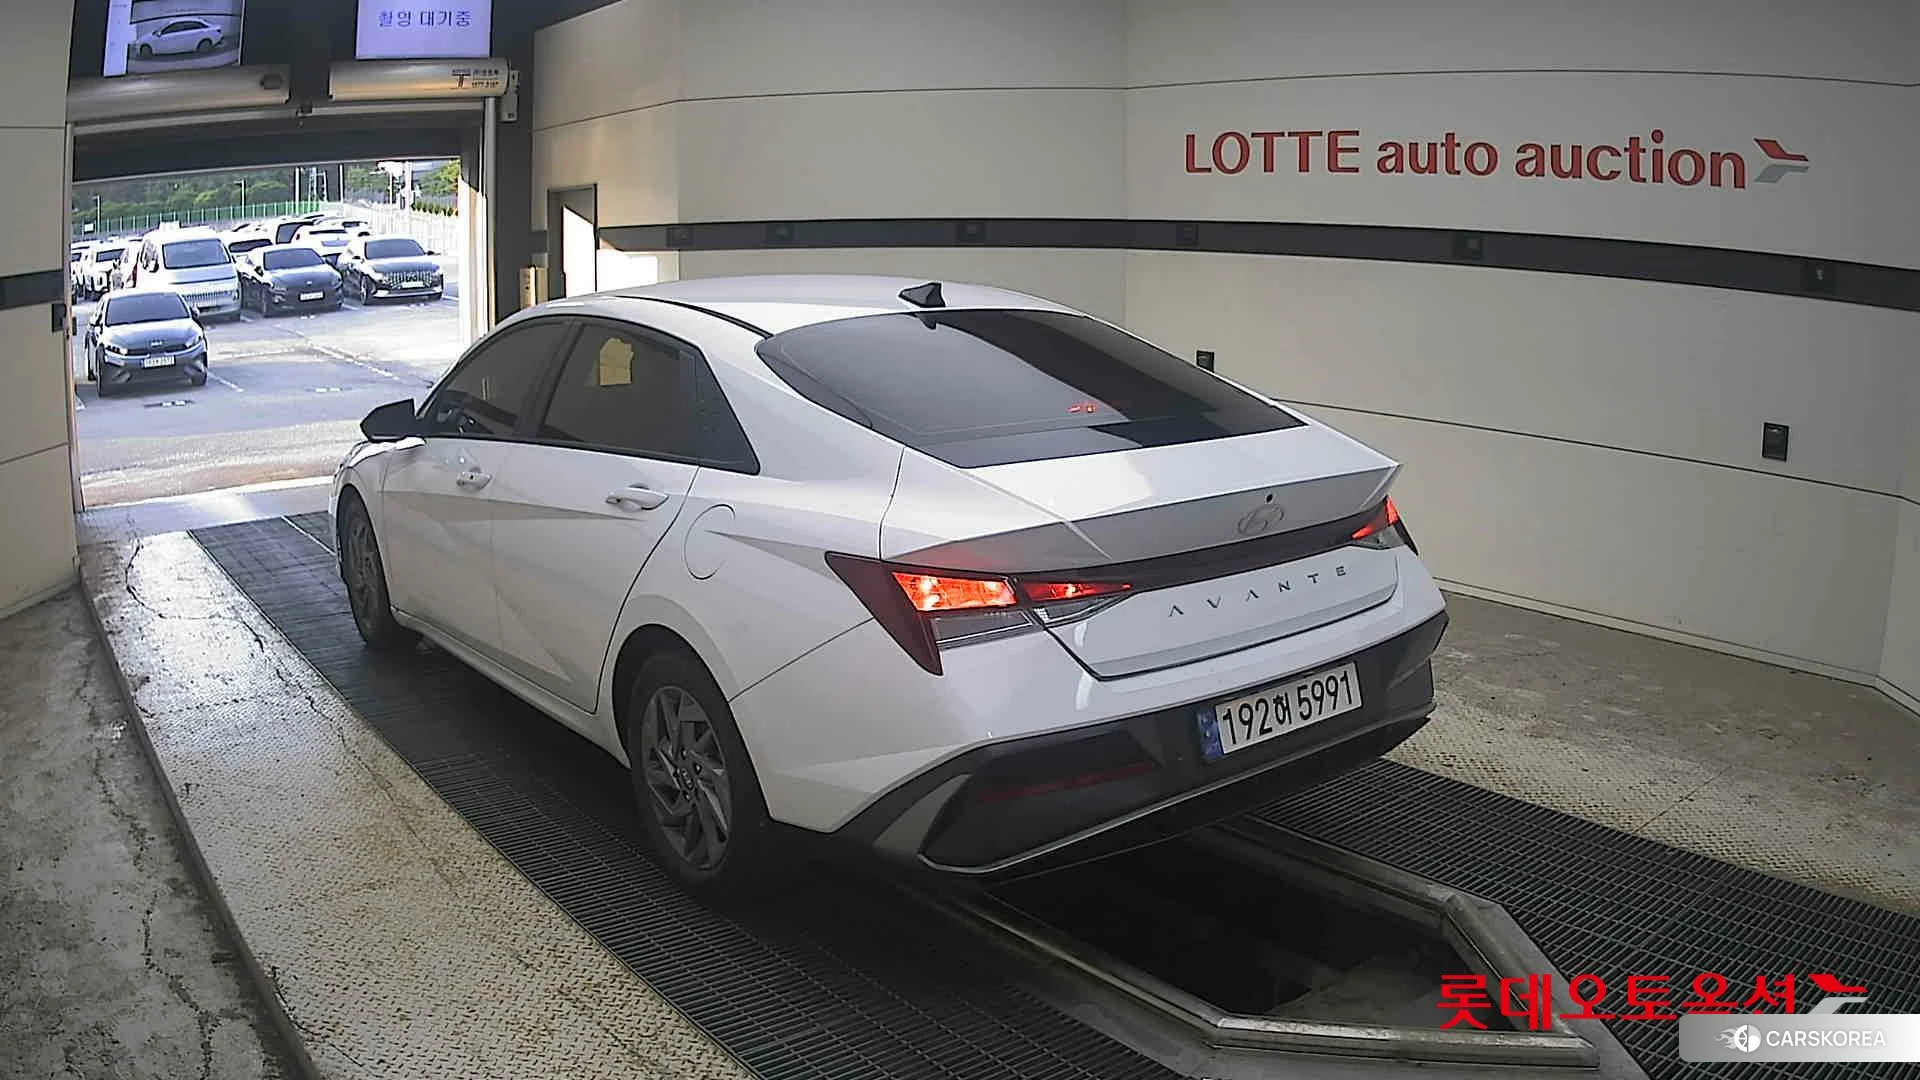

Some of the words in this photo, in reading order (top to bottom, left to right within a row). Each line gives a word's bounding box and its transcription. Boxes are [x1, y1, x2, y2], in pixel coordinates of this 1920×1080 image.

[420, 10, 472, 27] 대기중
[1185, 130, 1360, 174] LOTTE
[1376, 132, 1499, 176] auto
[1515, 129, 1746, 189] auction
[1169, 566, 1347, 617] AVANTE
[1222, 692, 1292, 744] 192허
[1296, 670, 1353, 721] 5991
